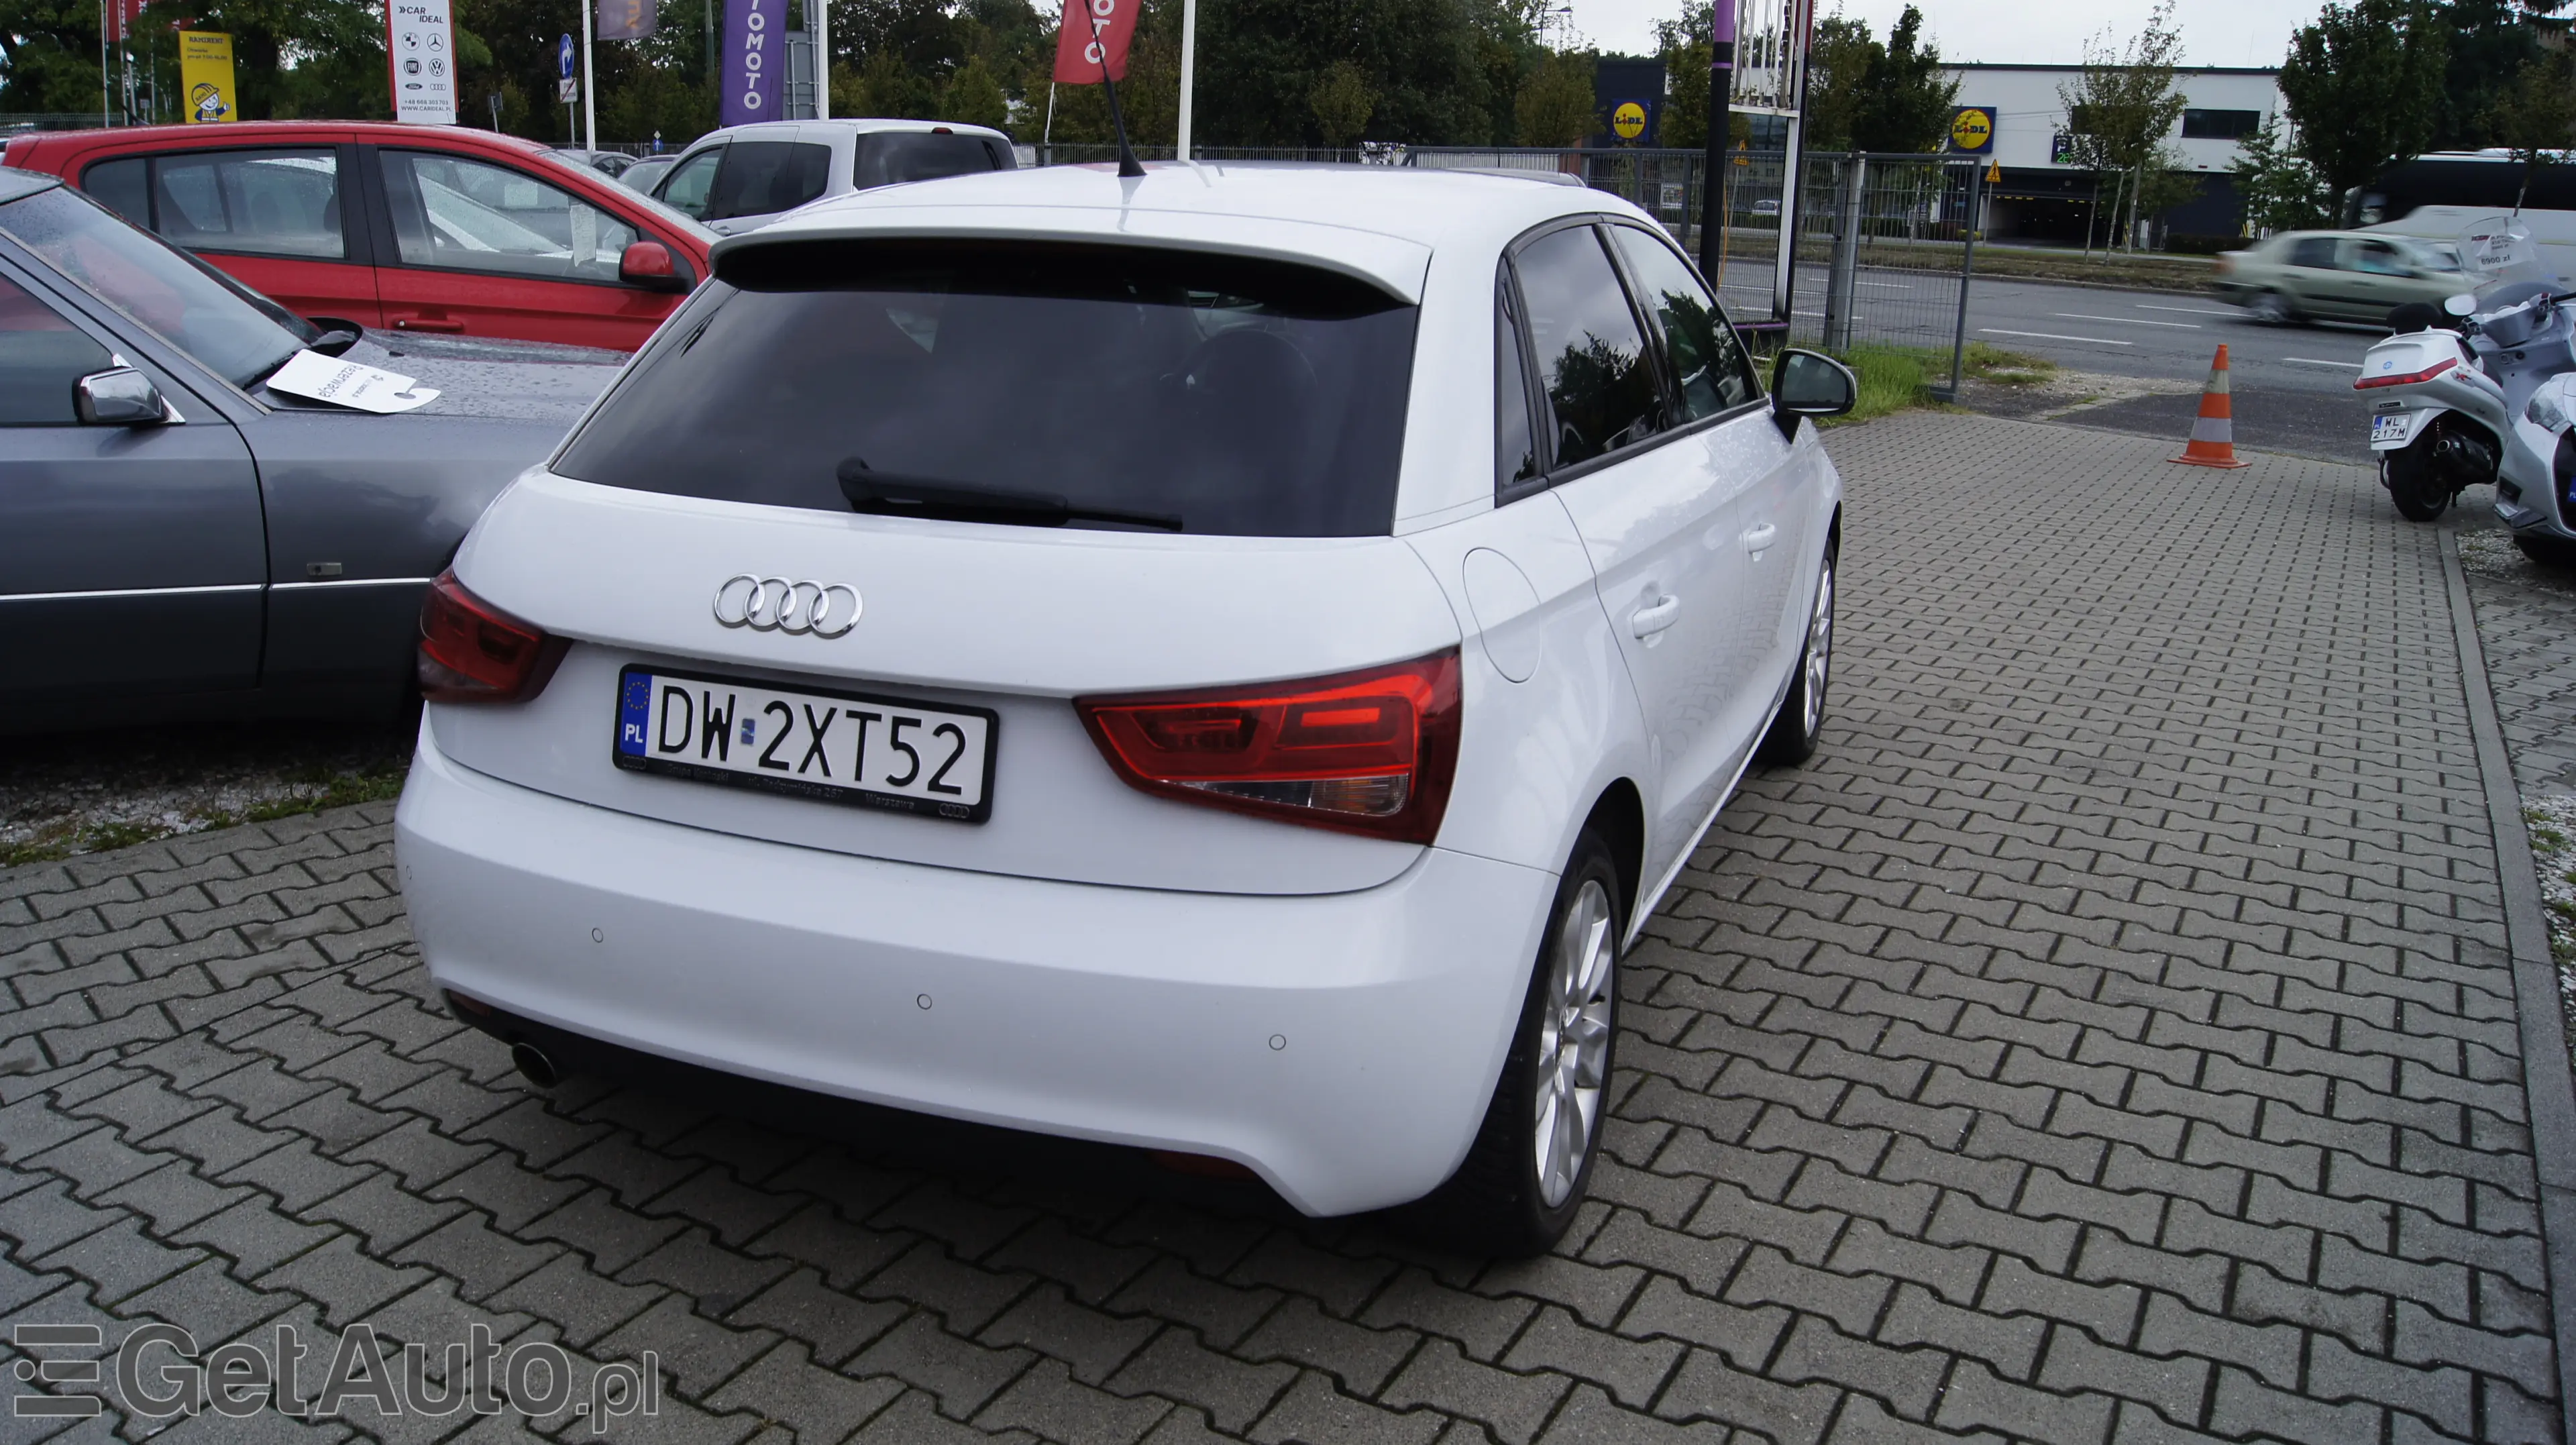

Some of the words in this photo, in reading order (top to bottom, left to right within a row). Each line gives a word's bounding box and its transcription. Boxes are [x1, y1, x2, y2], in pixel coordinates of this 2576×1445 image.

[407, 6, 426, 14] CAR
[419, 15, 444, 23] IDEAL
[407, 62, 418, 72] FIAT
[2385, 417, 2400, 427] WL
[2373, 428, 2406, 439] 217M
[625, 724, 643, 743] PL
[658, 685, 736, 762] DW
[757, 700, 967, 796] 2XT52
